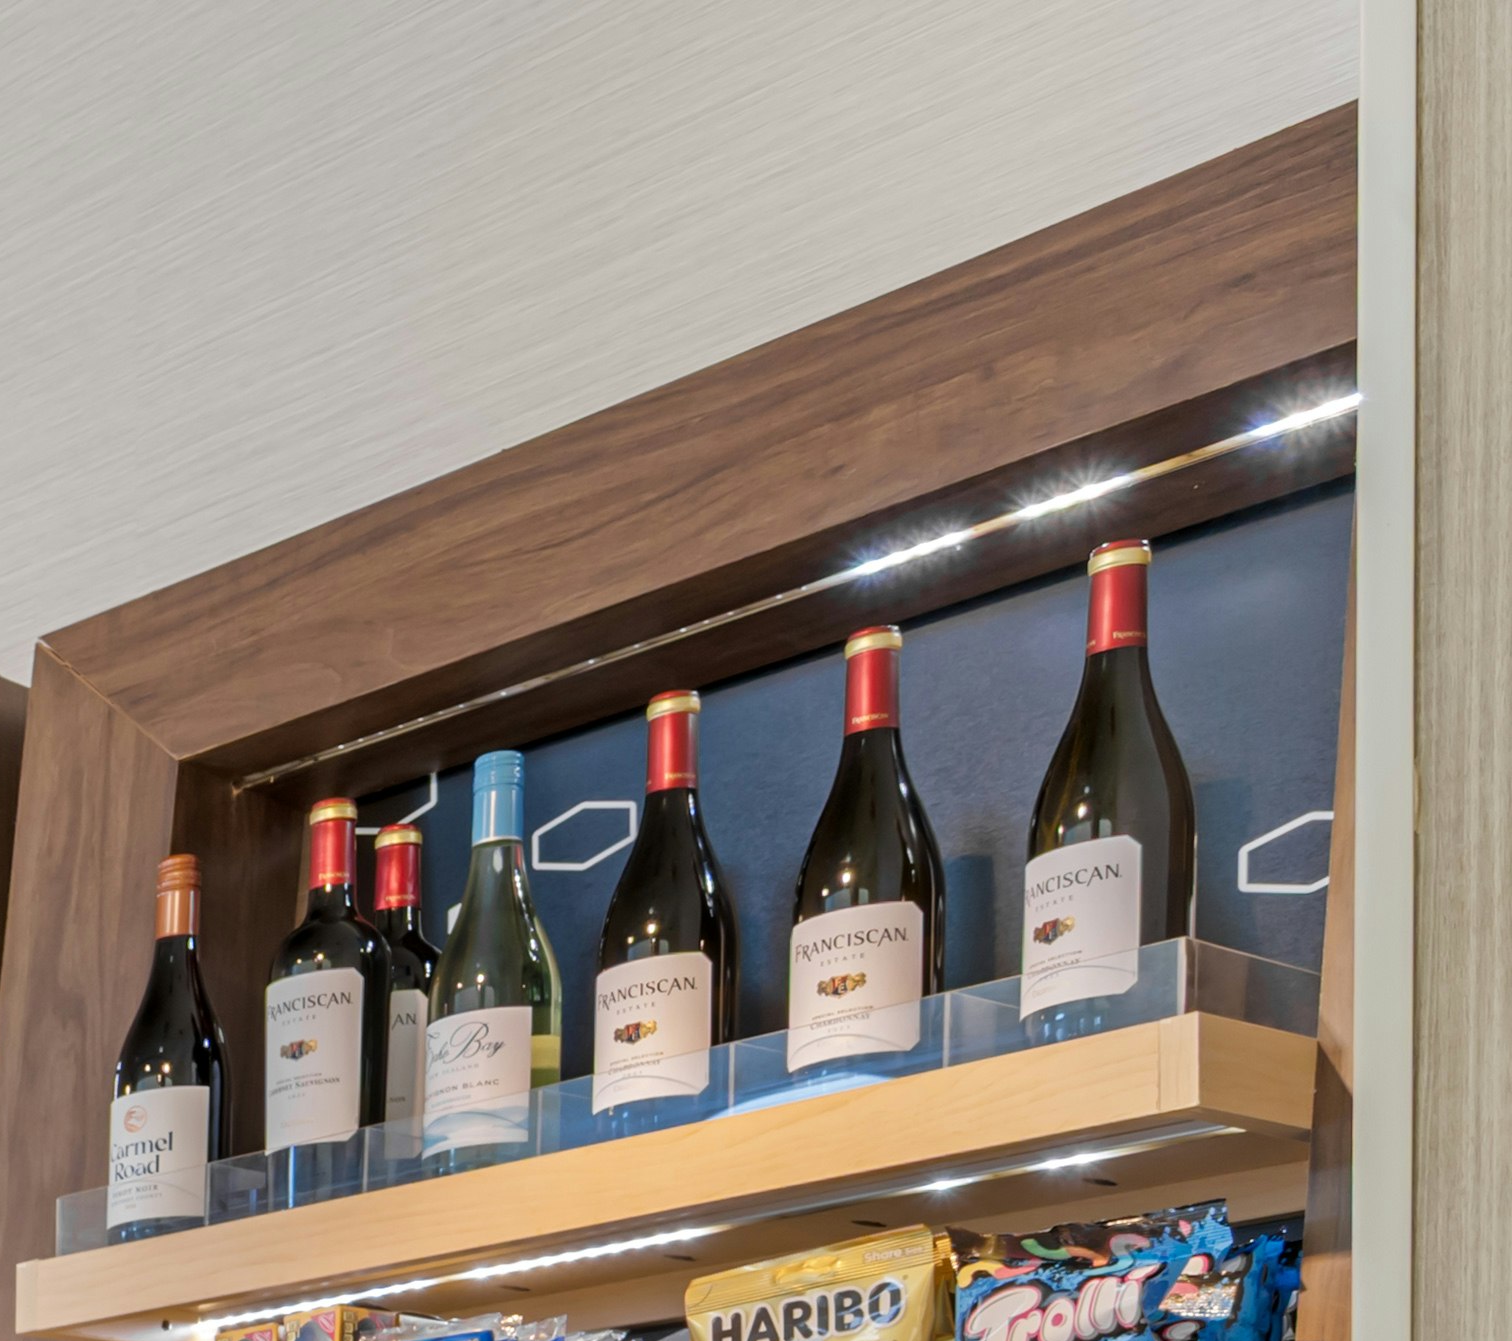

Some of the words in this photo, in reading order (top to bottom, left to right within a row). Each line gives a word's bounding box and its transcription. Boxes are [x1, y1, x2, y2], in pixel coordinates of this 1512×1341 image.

[795, 927, 908, 964] FRANCISCAN
[820, 953, 865, 967] ESTATE
[462, 1079, 500, 1089] BLANC
[115, 1155, 159, 1181] Road
